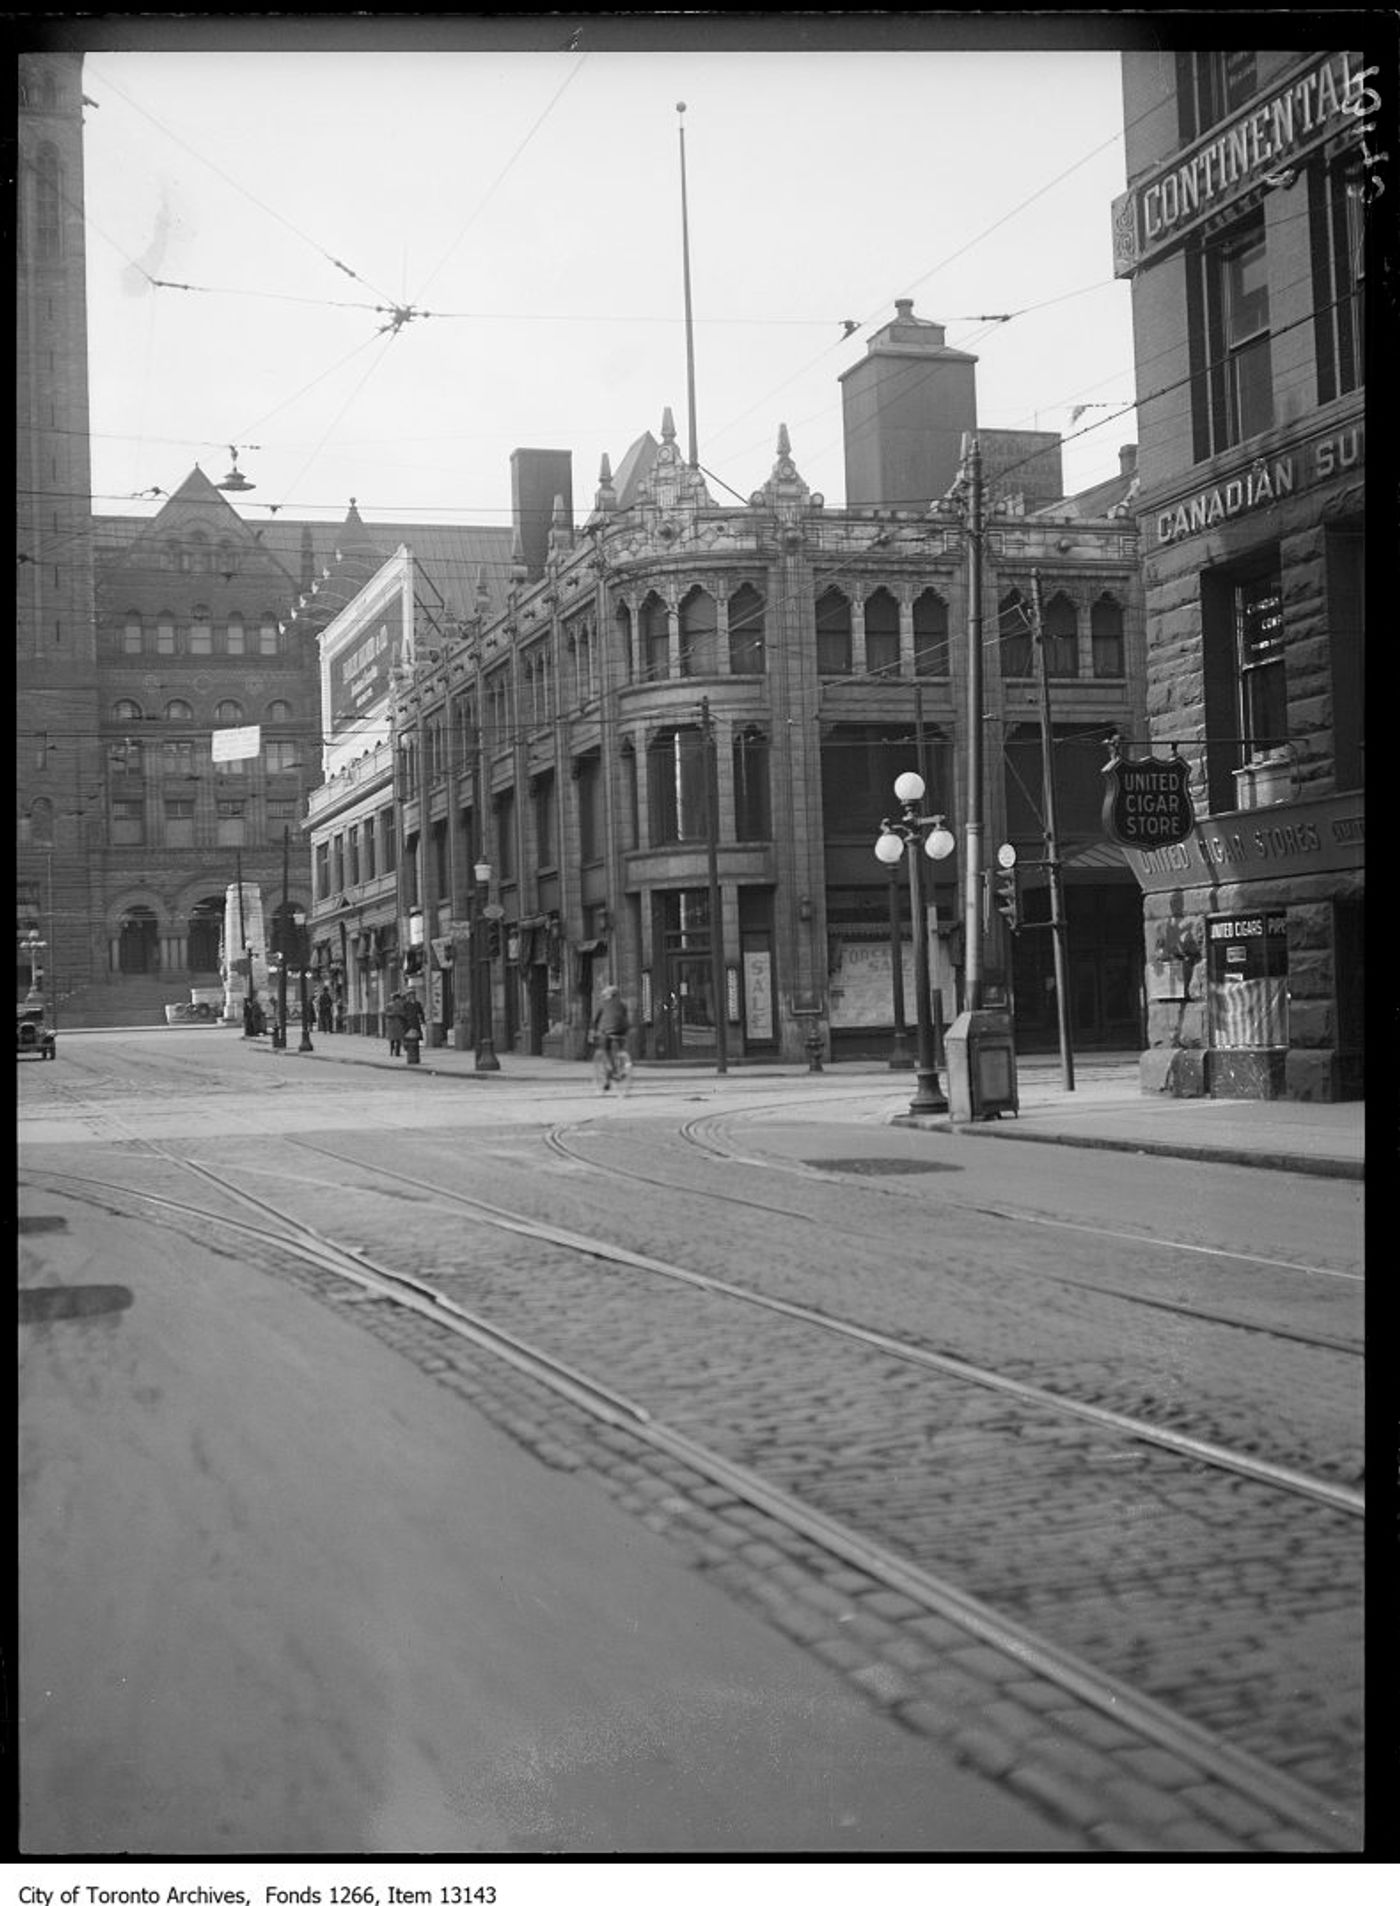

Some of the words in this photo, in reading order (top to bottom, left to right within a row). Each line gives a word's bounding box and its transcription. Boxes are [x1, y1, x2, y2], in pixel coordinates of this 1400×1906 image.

[1144, 51, 1363, 238] CONTINENTAL
[1157, 458, 1294, 543] CANADIAN
[1124, 773, 1179, 791] UNITED
[1125, 795, 1179, 813] CIGAR
[1126, 816, 1181, 836] STORE
[1139, 843, 1191, 874] UNITED
[1254, 823, 1321, 860] STORES
[750, 959, 768, 1029] SALE
